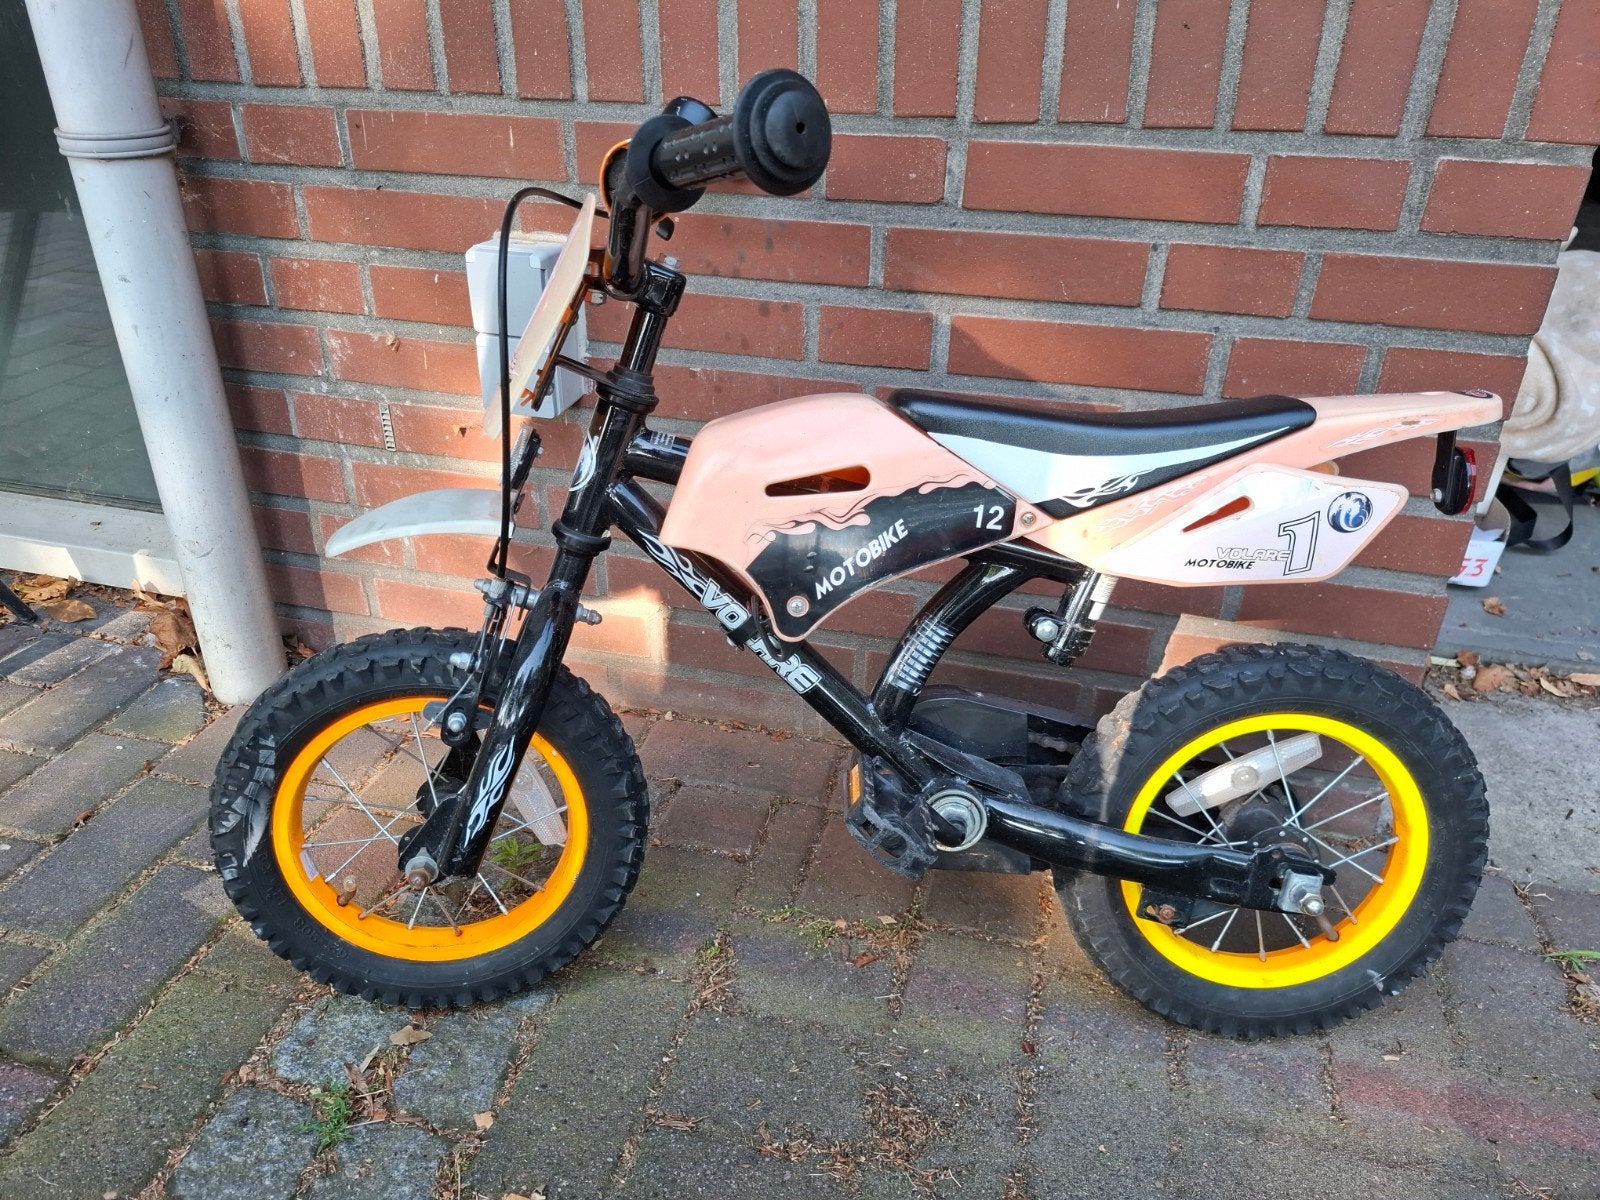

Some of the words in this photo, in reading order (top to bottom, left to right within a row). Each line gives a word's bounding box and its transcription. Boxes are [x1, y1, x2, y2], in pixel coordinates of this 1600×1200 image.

[972, 503, 1005, 531] 12
[1216, 546, 1292, 562] VOLARE
[1278, 510, 1320, 576] 1
[815, 518, 909, 600] MOTOBIKE
[1184, 558, 1255, 570] MOTOBIKE
